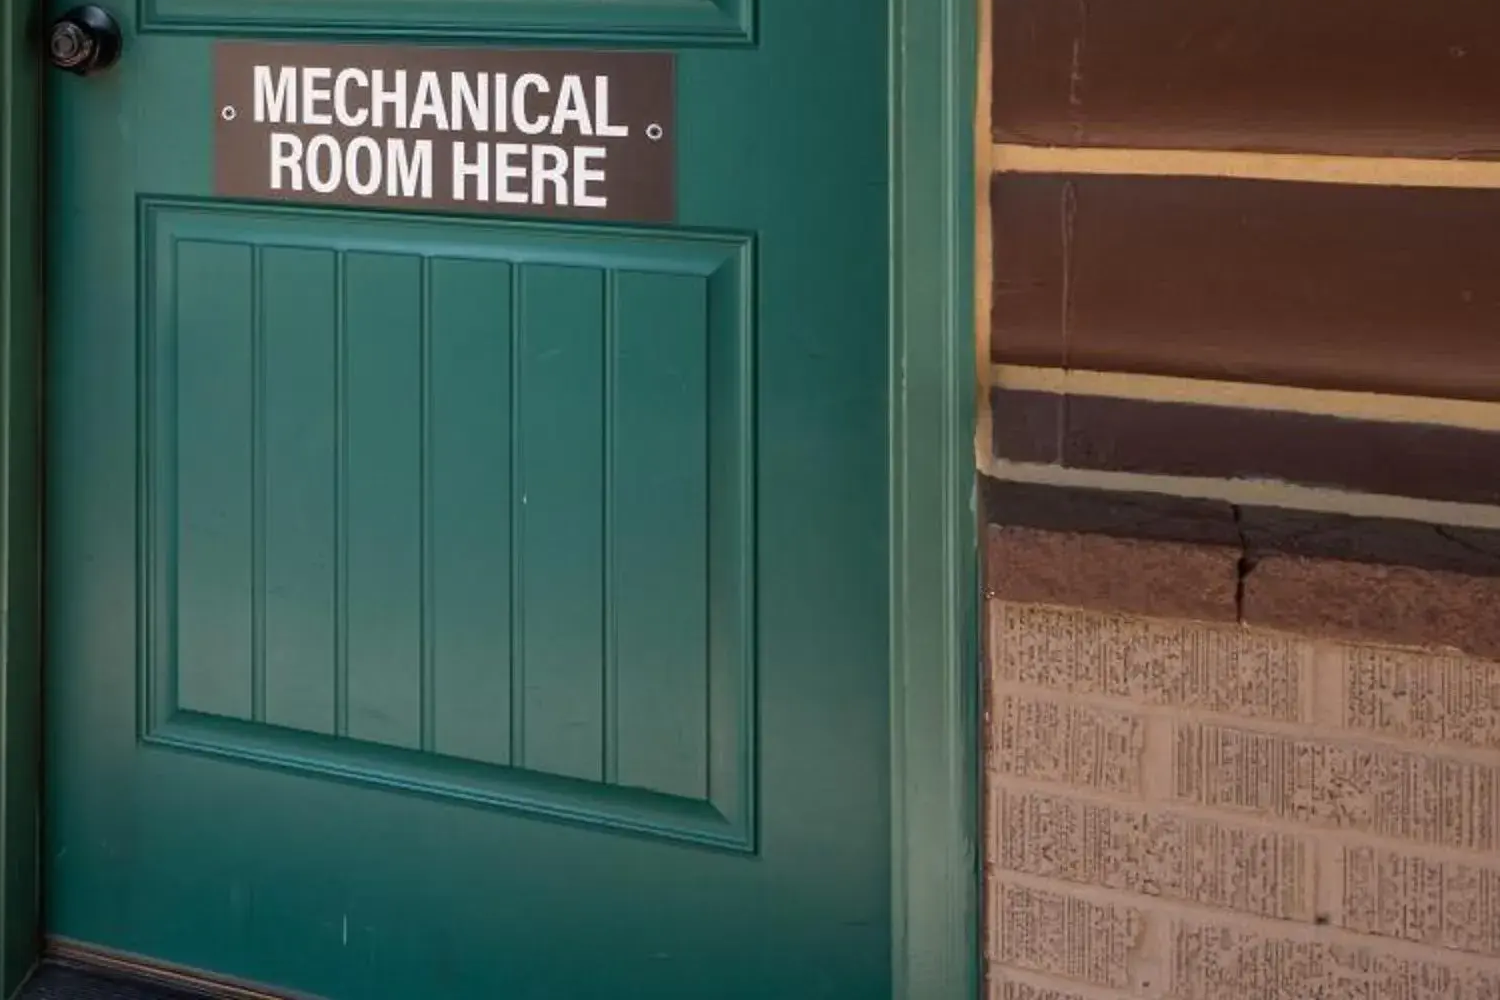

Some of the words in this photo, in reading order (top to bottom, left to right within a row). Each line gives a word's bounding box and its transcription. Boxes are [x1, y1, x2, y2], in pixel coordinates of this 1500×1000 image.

[253, 66, 629, 137] MECHANICAL
[270, 133, 433, 198] ROOM
[453, 140, 608, 208] HERE
